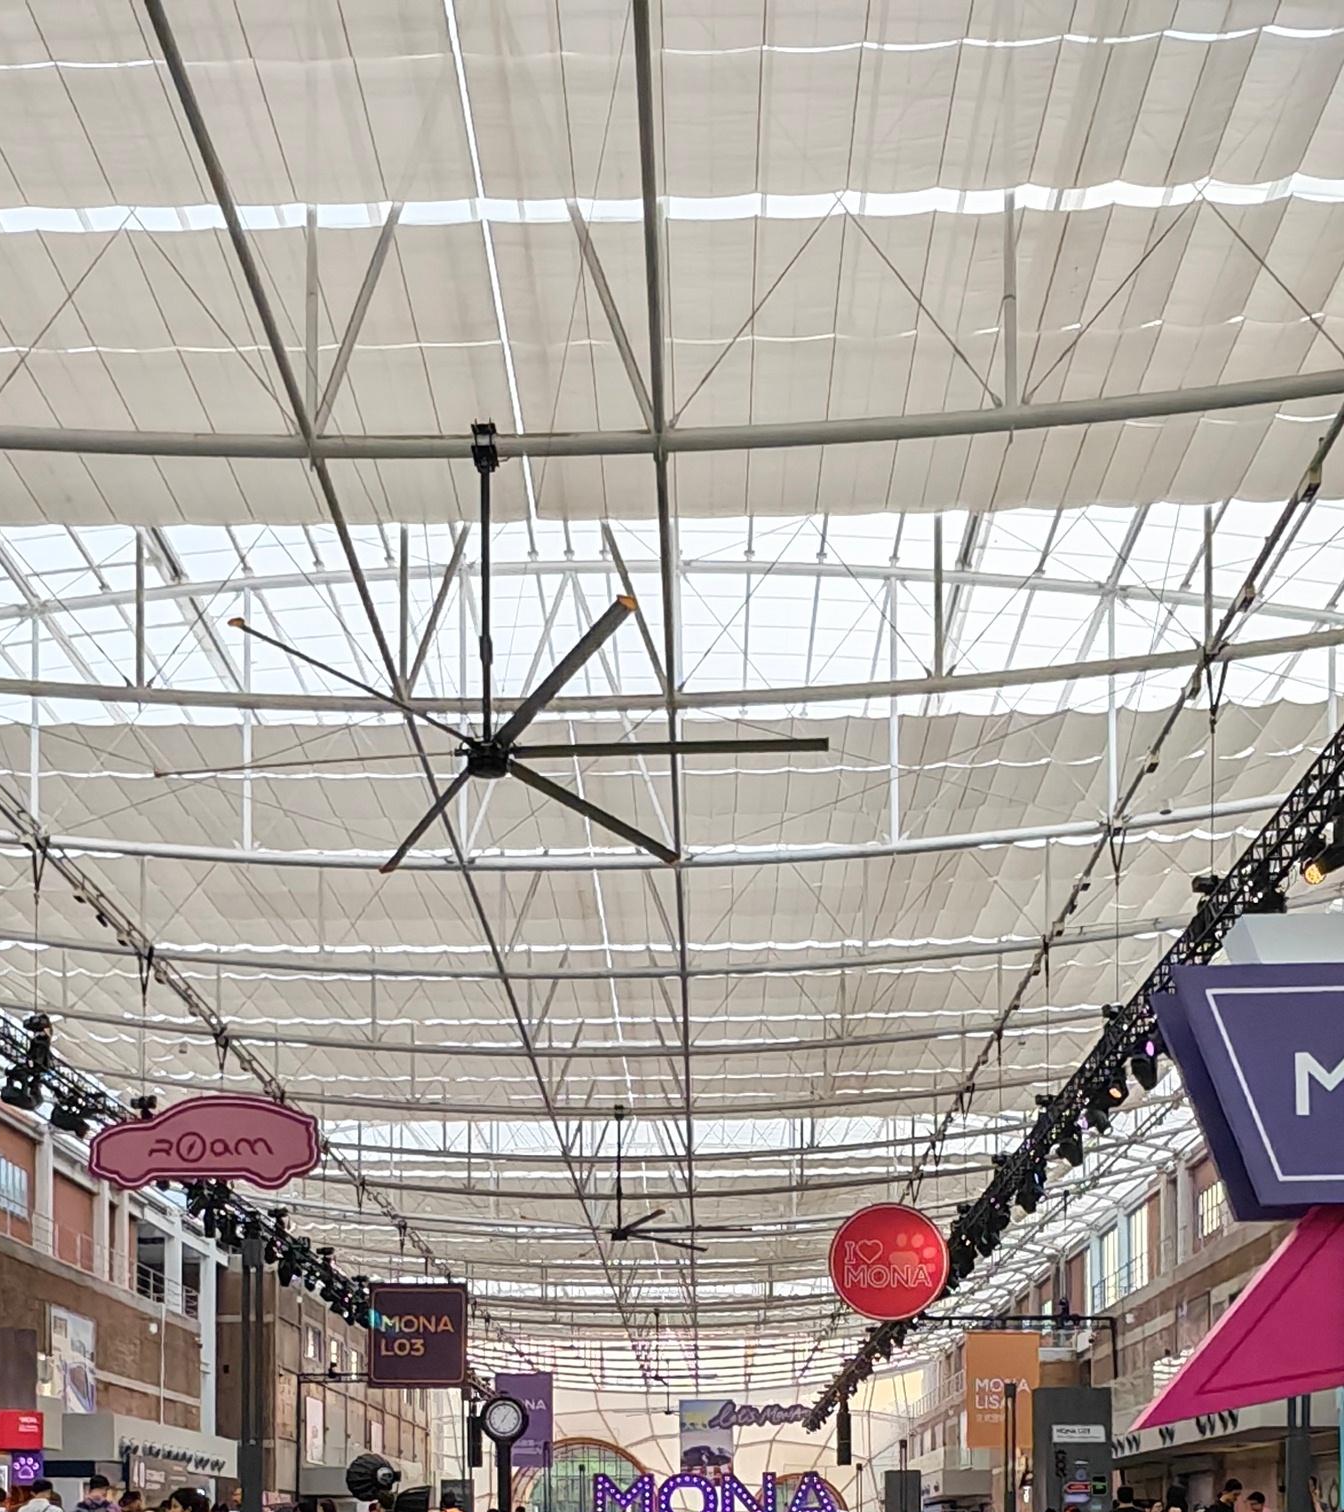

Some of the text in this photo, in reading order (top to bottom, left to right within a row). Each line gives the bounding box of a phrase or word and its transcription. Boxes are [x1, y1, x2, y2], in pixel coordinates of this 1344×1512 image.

[844, 1240, 856, 1264] I
[844, 1264, 933, 1289] MONA
[379, 1314, 455, 1333] MONA
[975, 1377, 1032, 1393] MOA
[524, 1398, 547, 1411] NA
